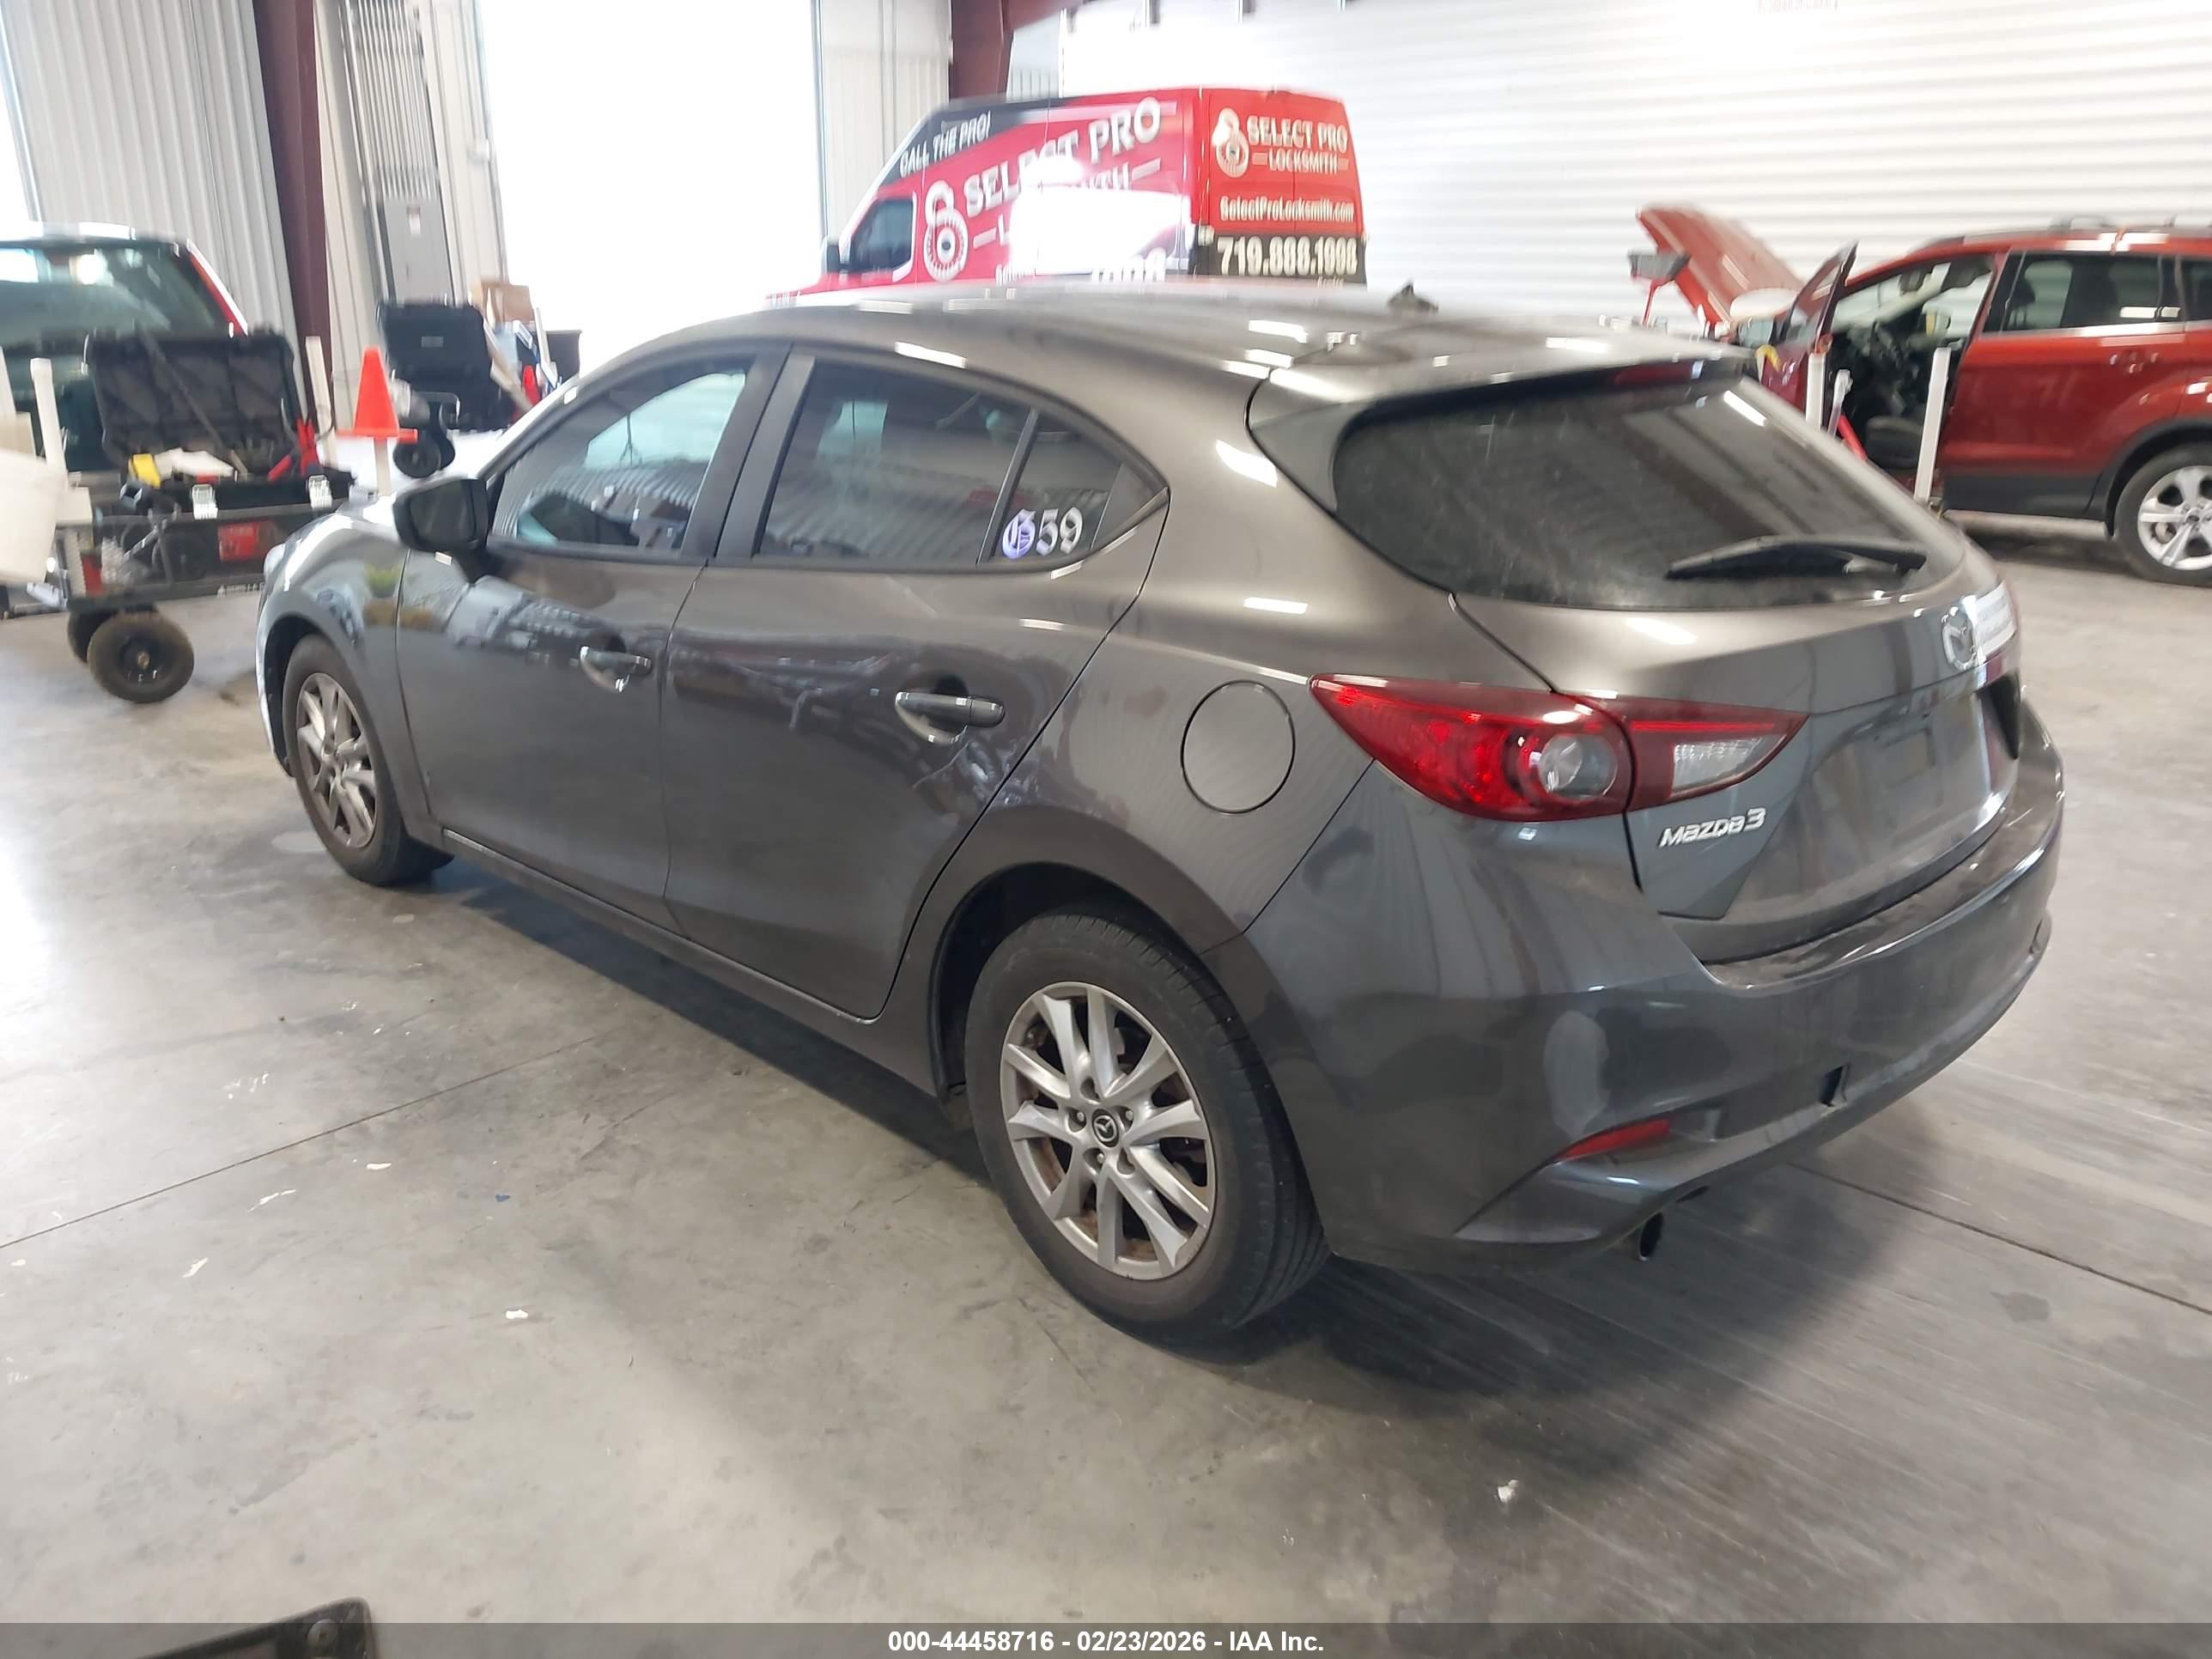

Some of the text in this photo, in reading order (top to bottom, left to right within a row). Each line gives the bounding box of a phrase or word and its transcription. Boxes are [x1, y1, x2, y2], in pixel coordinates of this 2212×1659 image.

[899, 140, 929, 179] CALL
[933, 125, 957, 163] THE
[1089, 97, 1161, 165] PRO
[1247, 114, 1348, 154] SELECT PRO
[1268, 149, 1339, 175] LOCKSMITH
